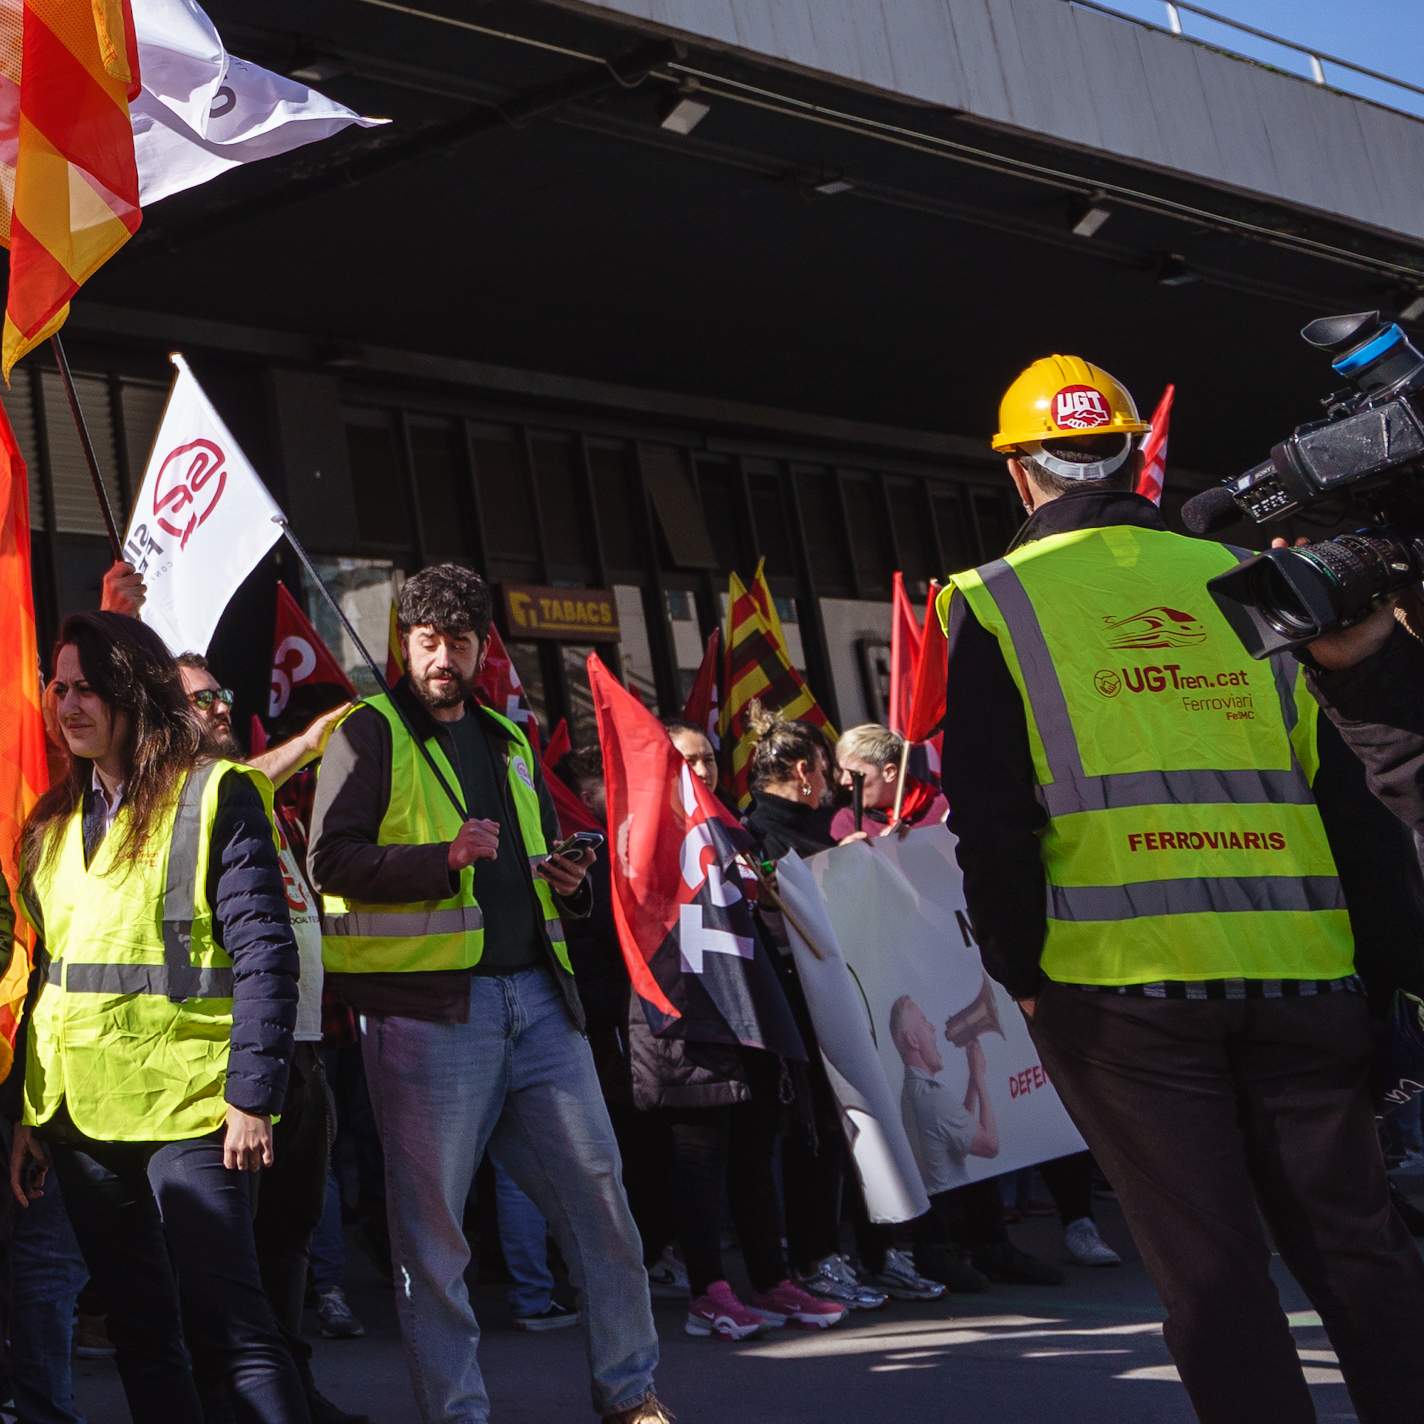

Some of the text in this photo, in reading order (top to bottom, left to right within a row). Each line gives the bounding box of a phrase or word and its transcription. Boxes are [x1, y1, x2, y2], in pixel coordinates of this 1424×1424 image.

[1056, 390, 1105, 416] UGT
[539, 597, 612, 625] TABACS
[1121, 664, 1250, 693] UGTren.cat
[1182, 693, 1254, 712] Ferroviari
[1128, 831, 1286, 852] FERROVIARIS
